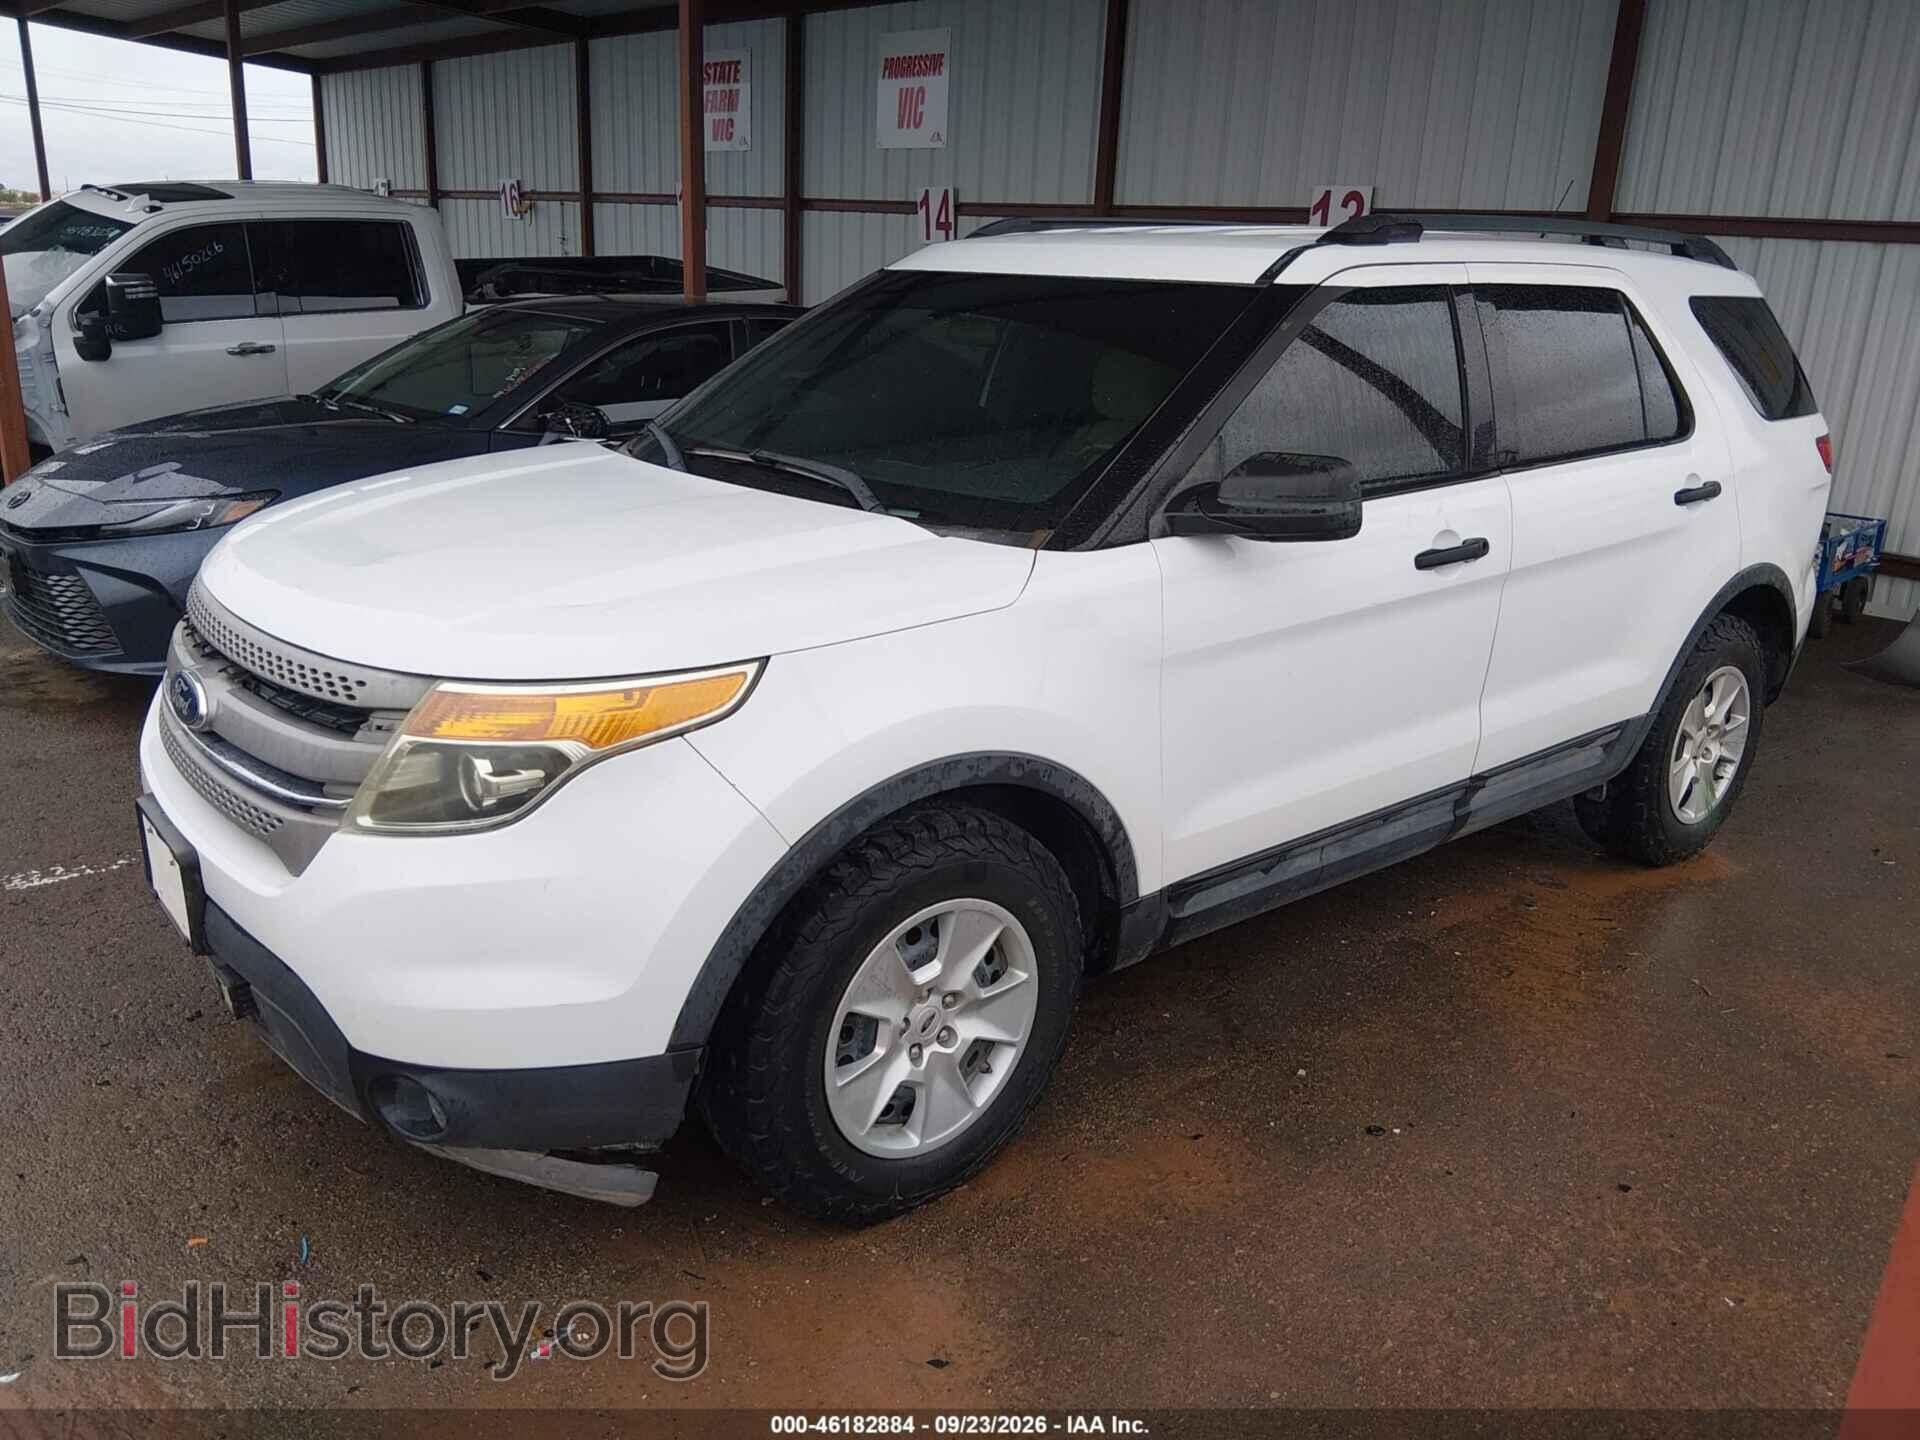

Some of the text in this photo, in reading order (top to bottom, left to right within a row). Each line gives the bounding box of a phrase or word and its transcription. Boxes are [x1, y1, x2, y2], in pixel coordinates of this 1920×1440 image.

[704, 61, 740, 85] STATE
[882, 53, 945, 80] PROGRESSIVE
[704, 88, 740, 112] FARM
[897, 86, 926, 129] VIC
[712, 118, 734, 142] VIC
[501, 182, 519, 217] 16
[920, 188, 953, 241] 14
